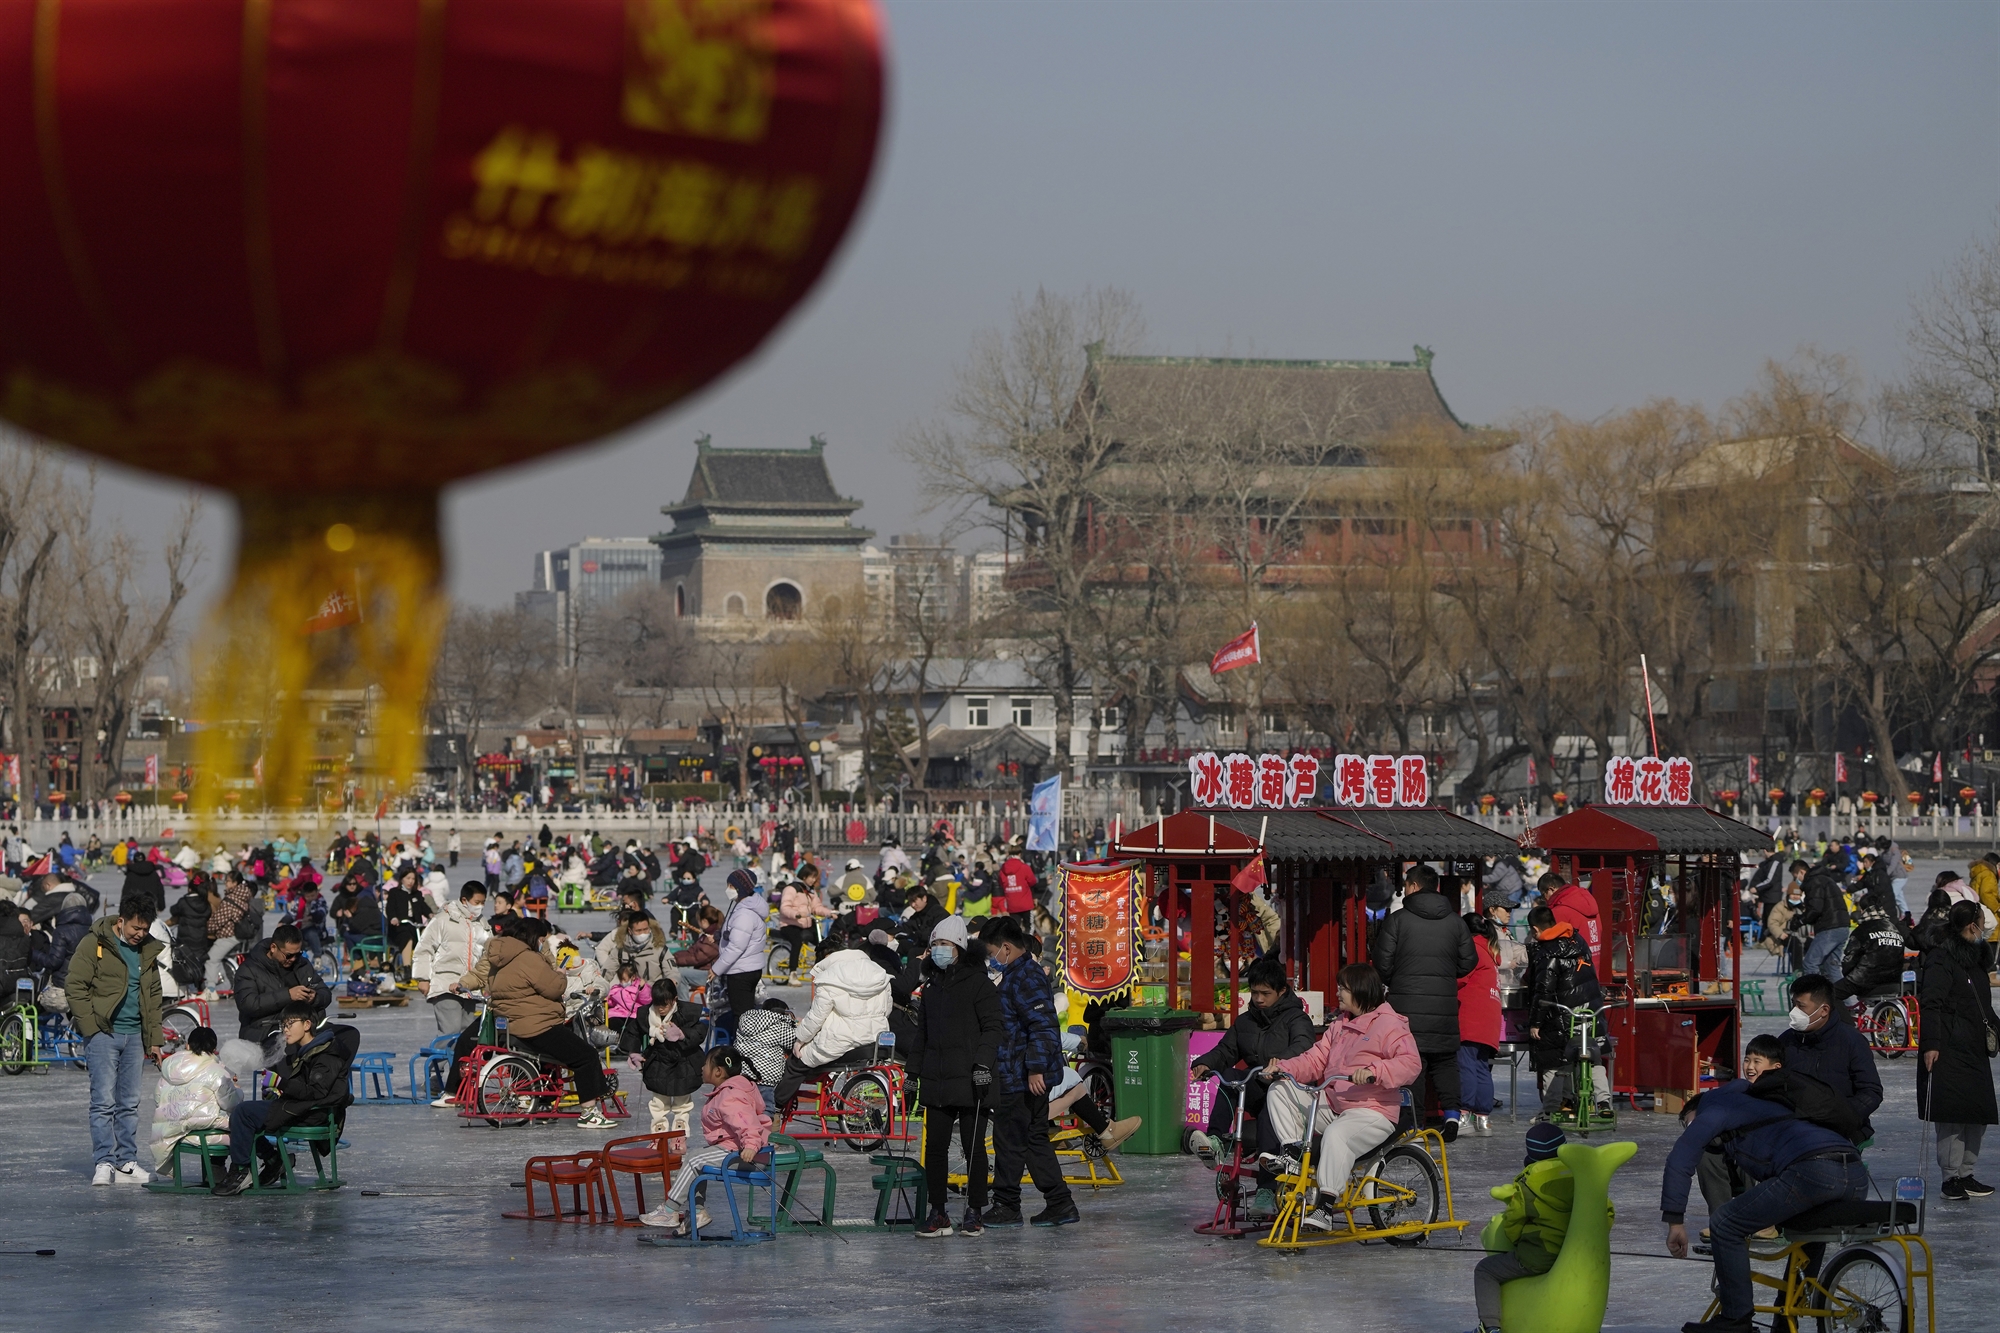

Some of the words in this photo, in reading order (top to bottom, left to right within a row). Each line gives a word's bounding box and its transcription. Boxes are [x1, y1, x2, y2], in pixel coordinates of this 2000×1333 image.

[1194, 755, 1318, 807] 冰糖葫芦
[1338, 756, 1427, 805] 烤香肠
[1608, 758, 1692, 803] 棉花糖
[1085, 890, 1107, 982] 冰糖葫芦
[1878, 938, 1902, 947] PEOPLE
